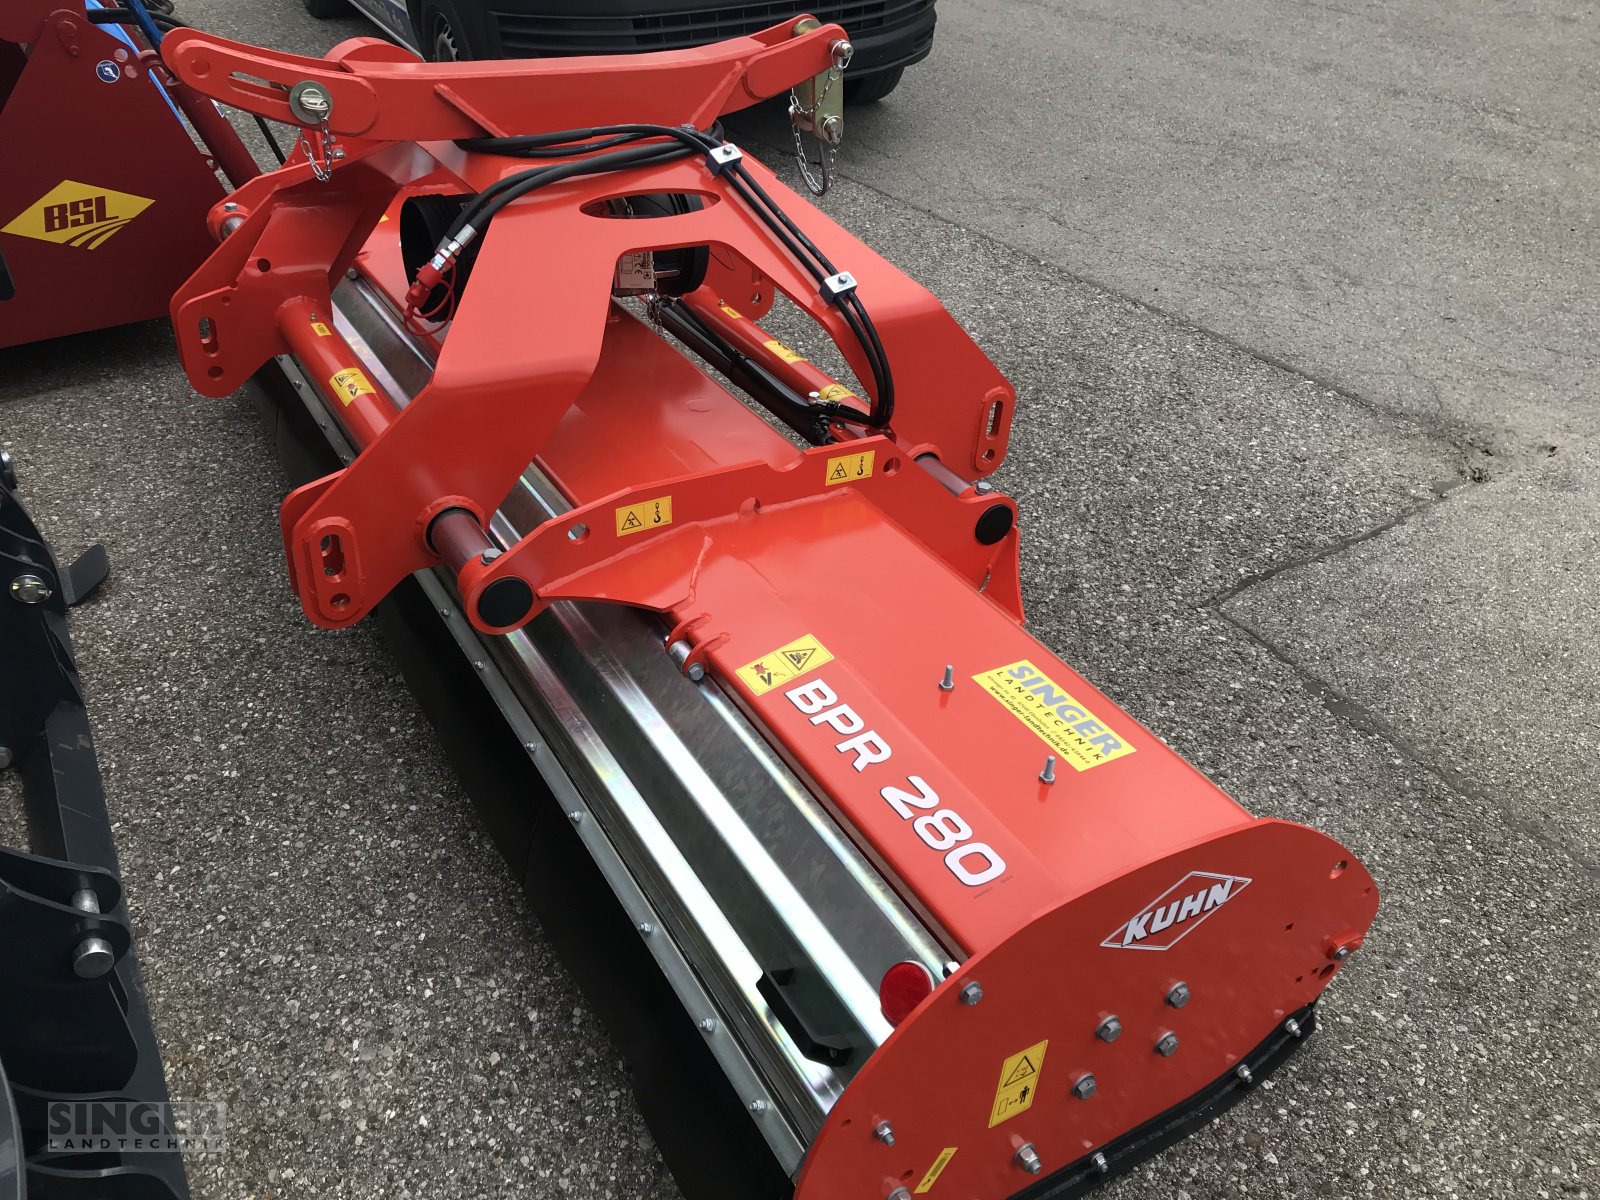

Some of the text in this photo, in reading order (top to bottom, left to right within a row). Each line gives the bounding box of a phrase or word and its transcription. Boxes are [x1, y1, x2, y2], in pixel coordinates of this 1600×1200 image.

[44, 196, 119, 233] BSL
[989, 686, 1071, 756] www.singer-landtechnik.de
[996, 671, 1104, 761] LANDTECHNIK
[1007, 665, 1122, 757] SINGER
[784, 678, 1007, 887] BPR 280
[1121, 877, 1234, 947] KUHN
